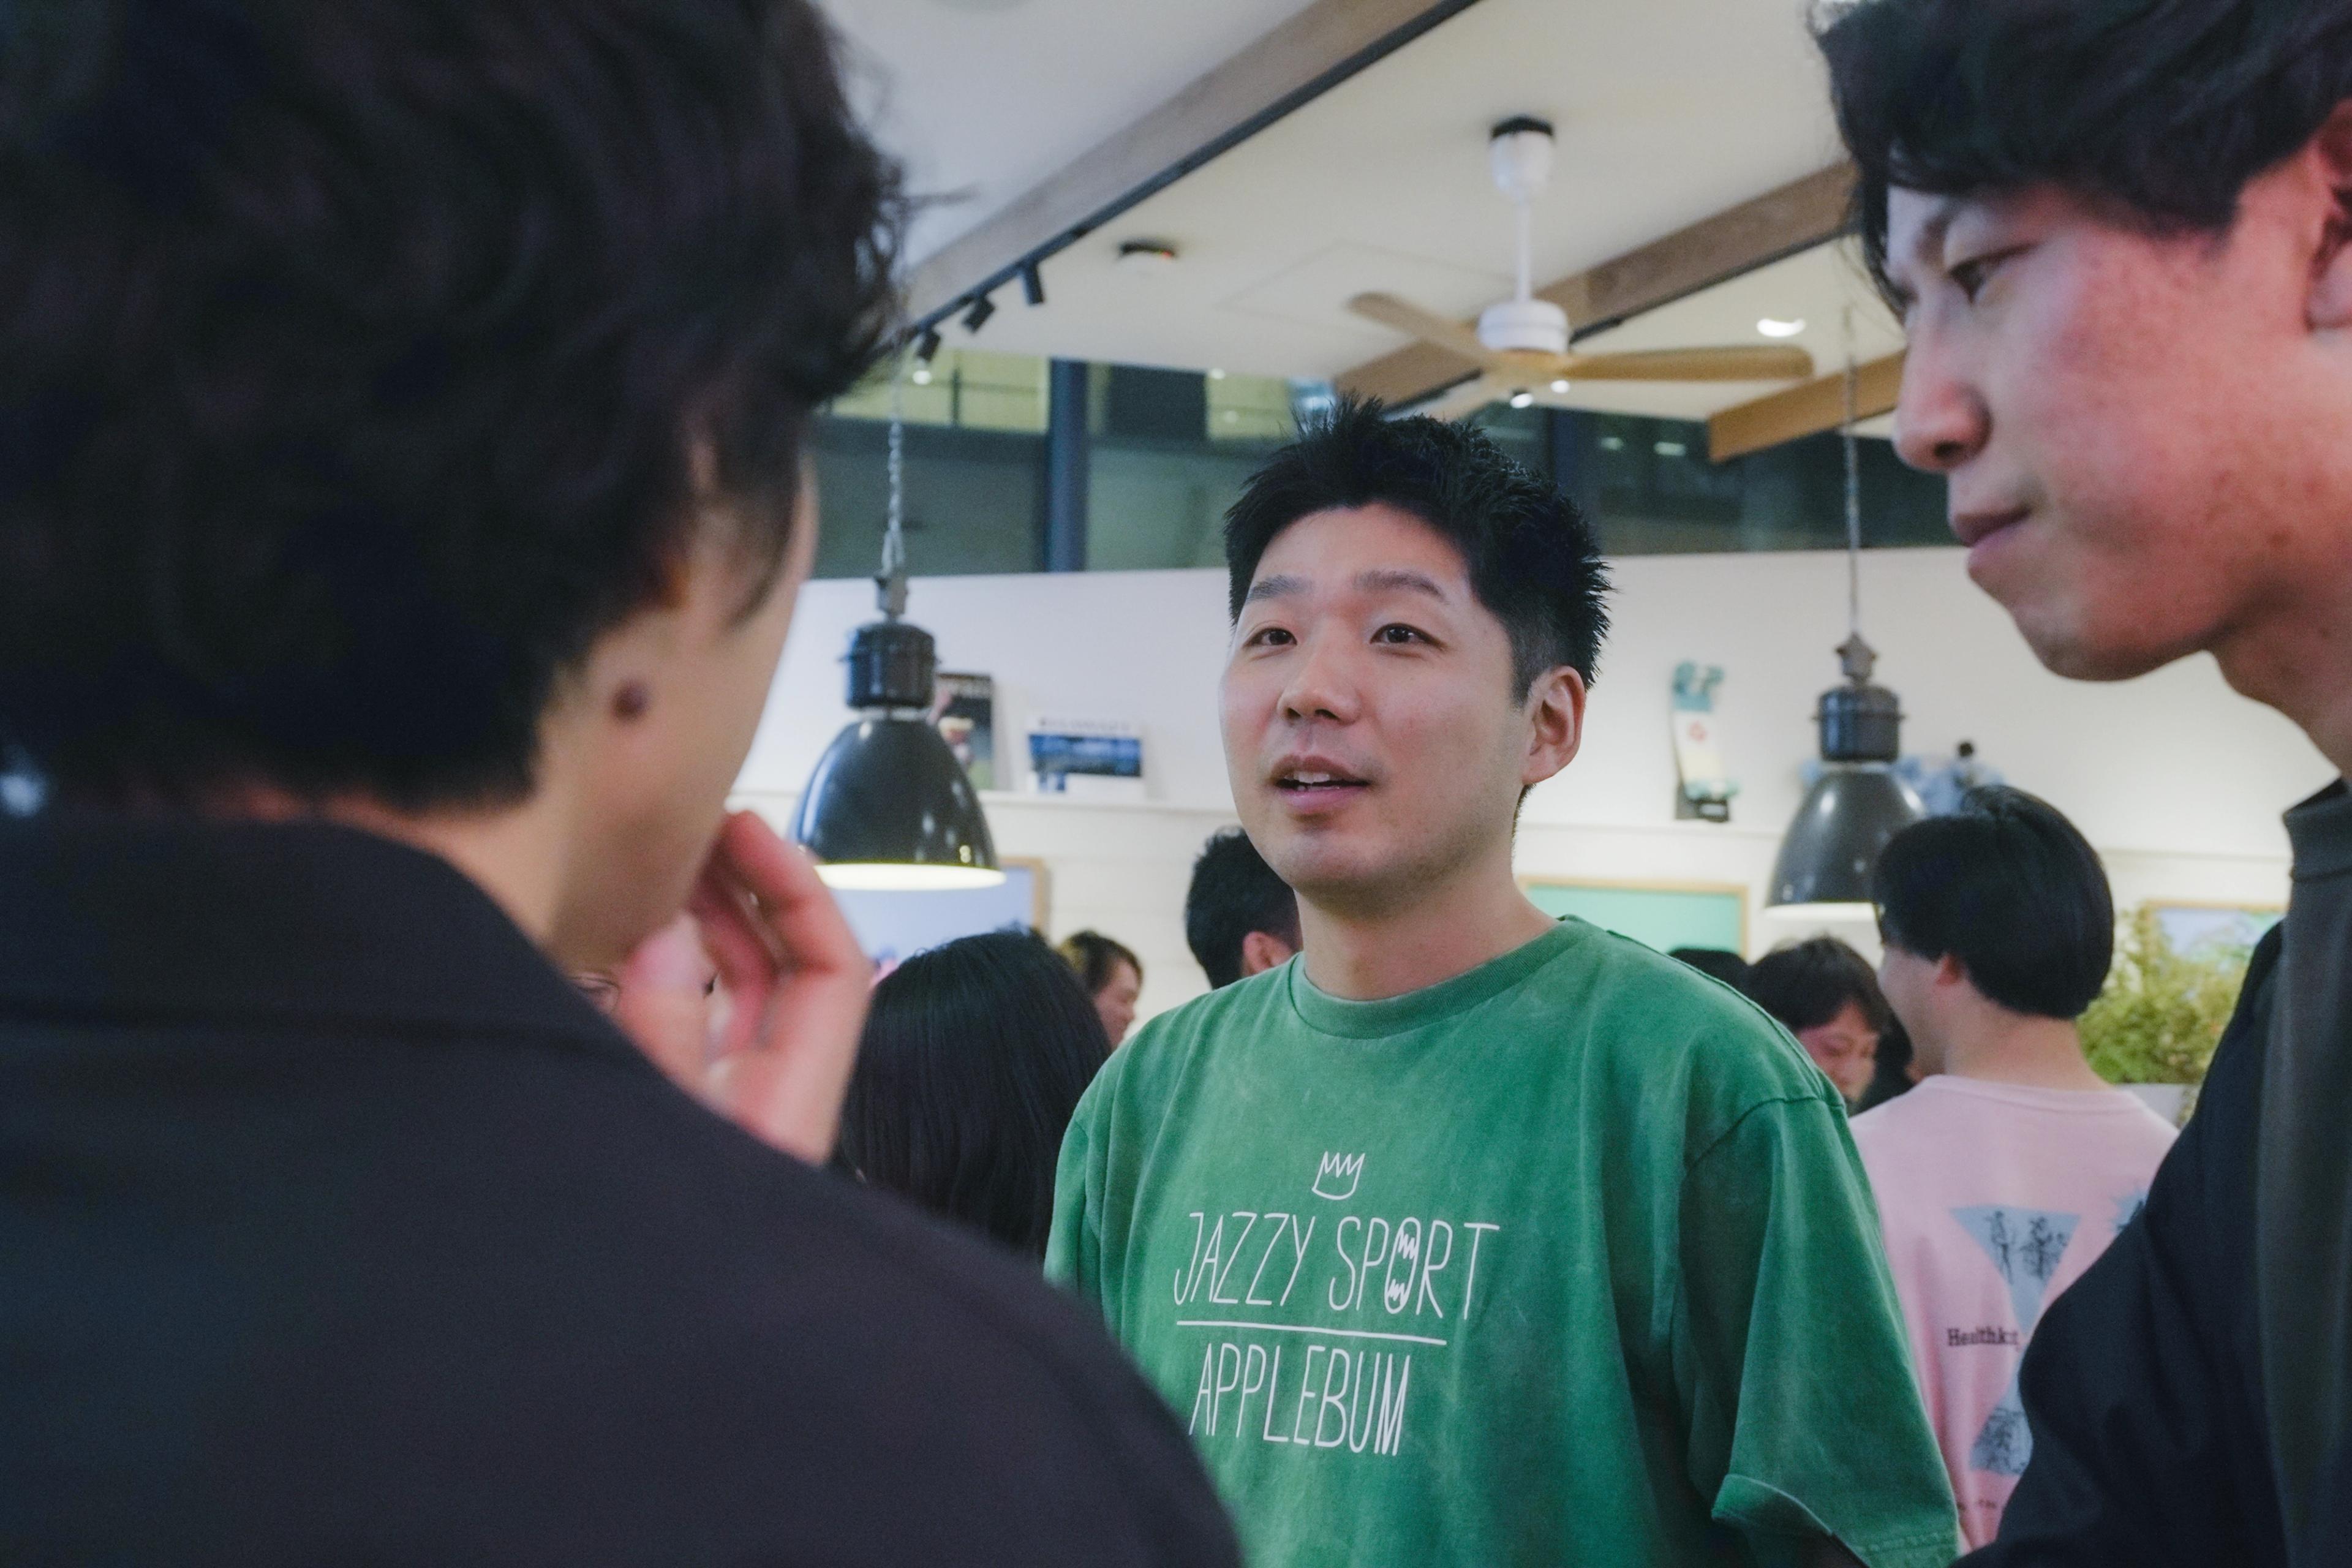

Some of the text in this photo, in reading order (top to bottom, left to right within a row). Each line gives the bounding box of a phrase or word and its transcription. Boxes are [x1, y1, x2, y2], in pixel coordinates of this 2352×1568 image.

[1174, 1212, 1500, 1320] JAZZY SPORT
[1189, 1343, 1411, 1457] APPLEBUM
